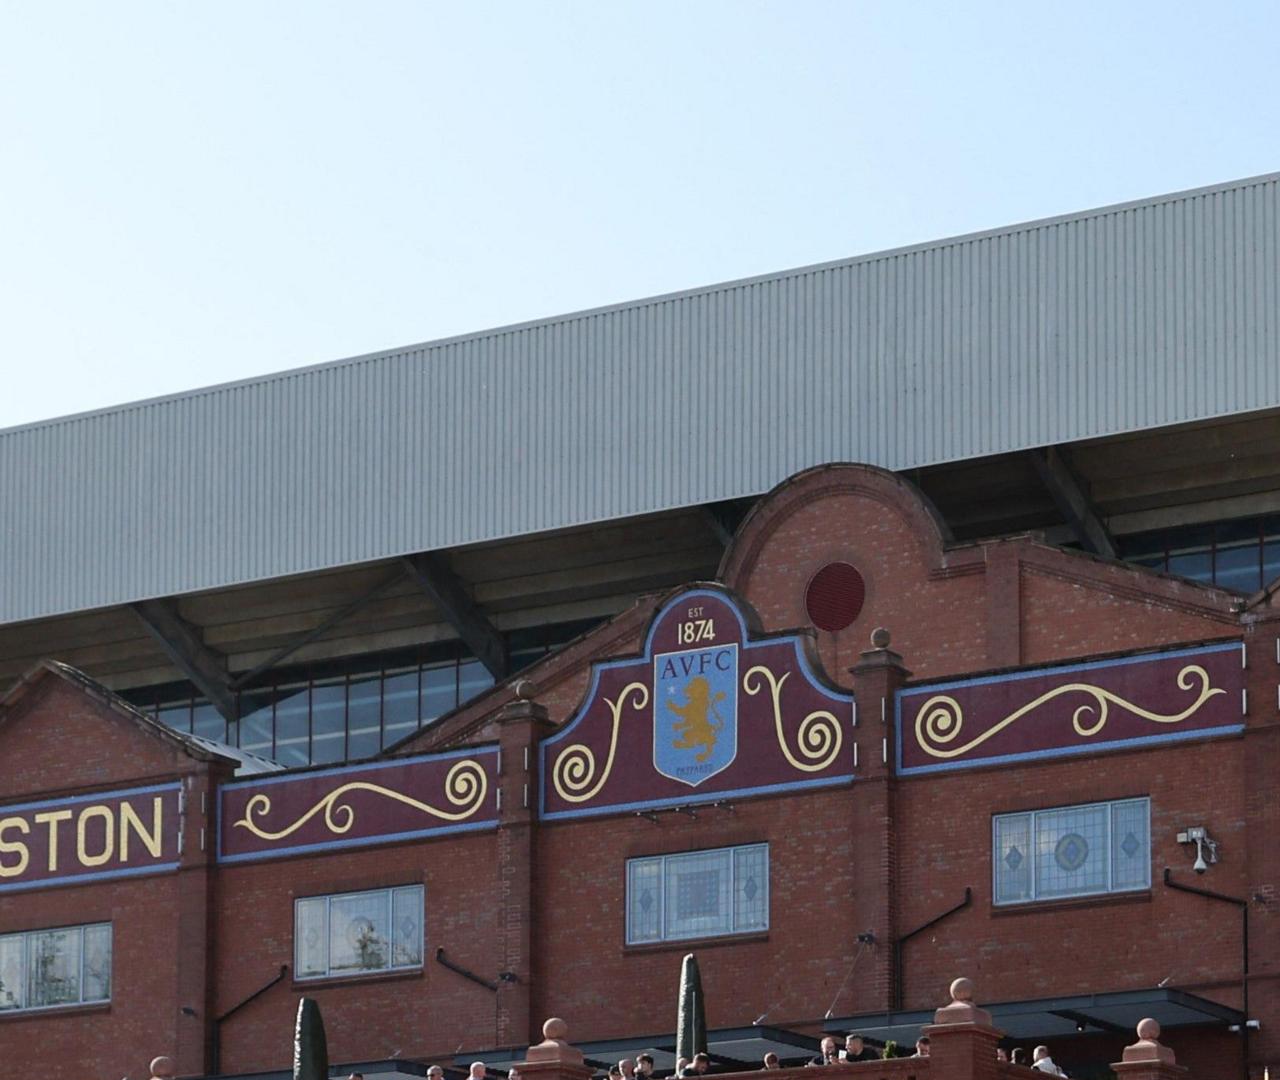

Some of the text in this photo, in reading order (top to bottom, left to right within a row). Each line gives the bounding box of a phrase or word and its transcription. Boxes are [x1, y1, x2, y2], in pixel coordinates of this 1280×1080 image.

[687, 606, 704, 618] EST
[677, 618, 716, 645] 1874
[660, 650, 732, 681] AVFC
[0, 796, 164, 878] STON
